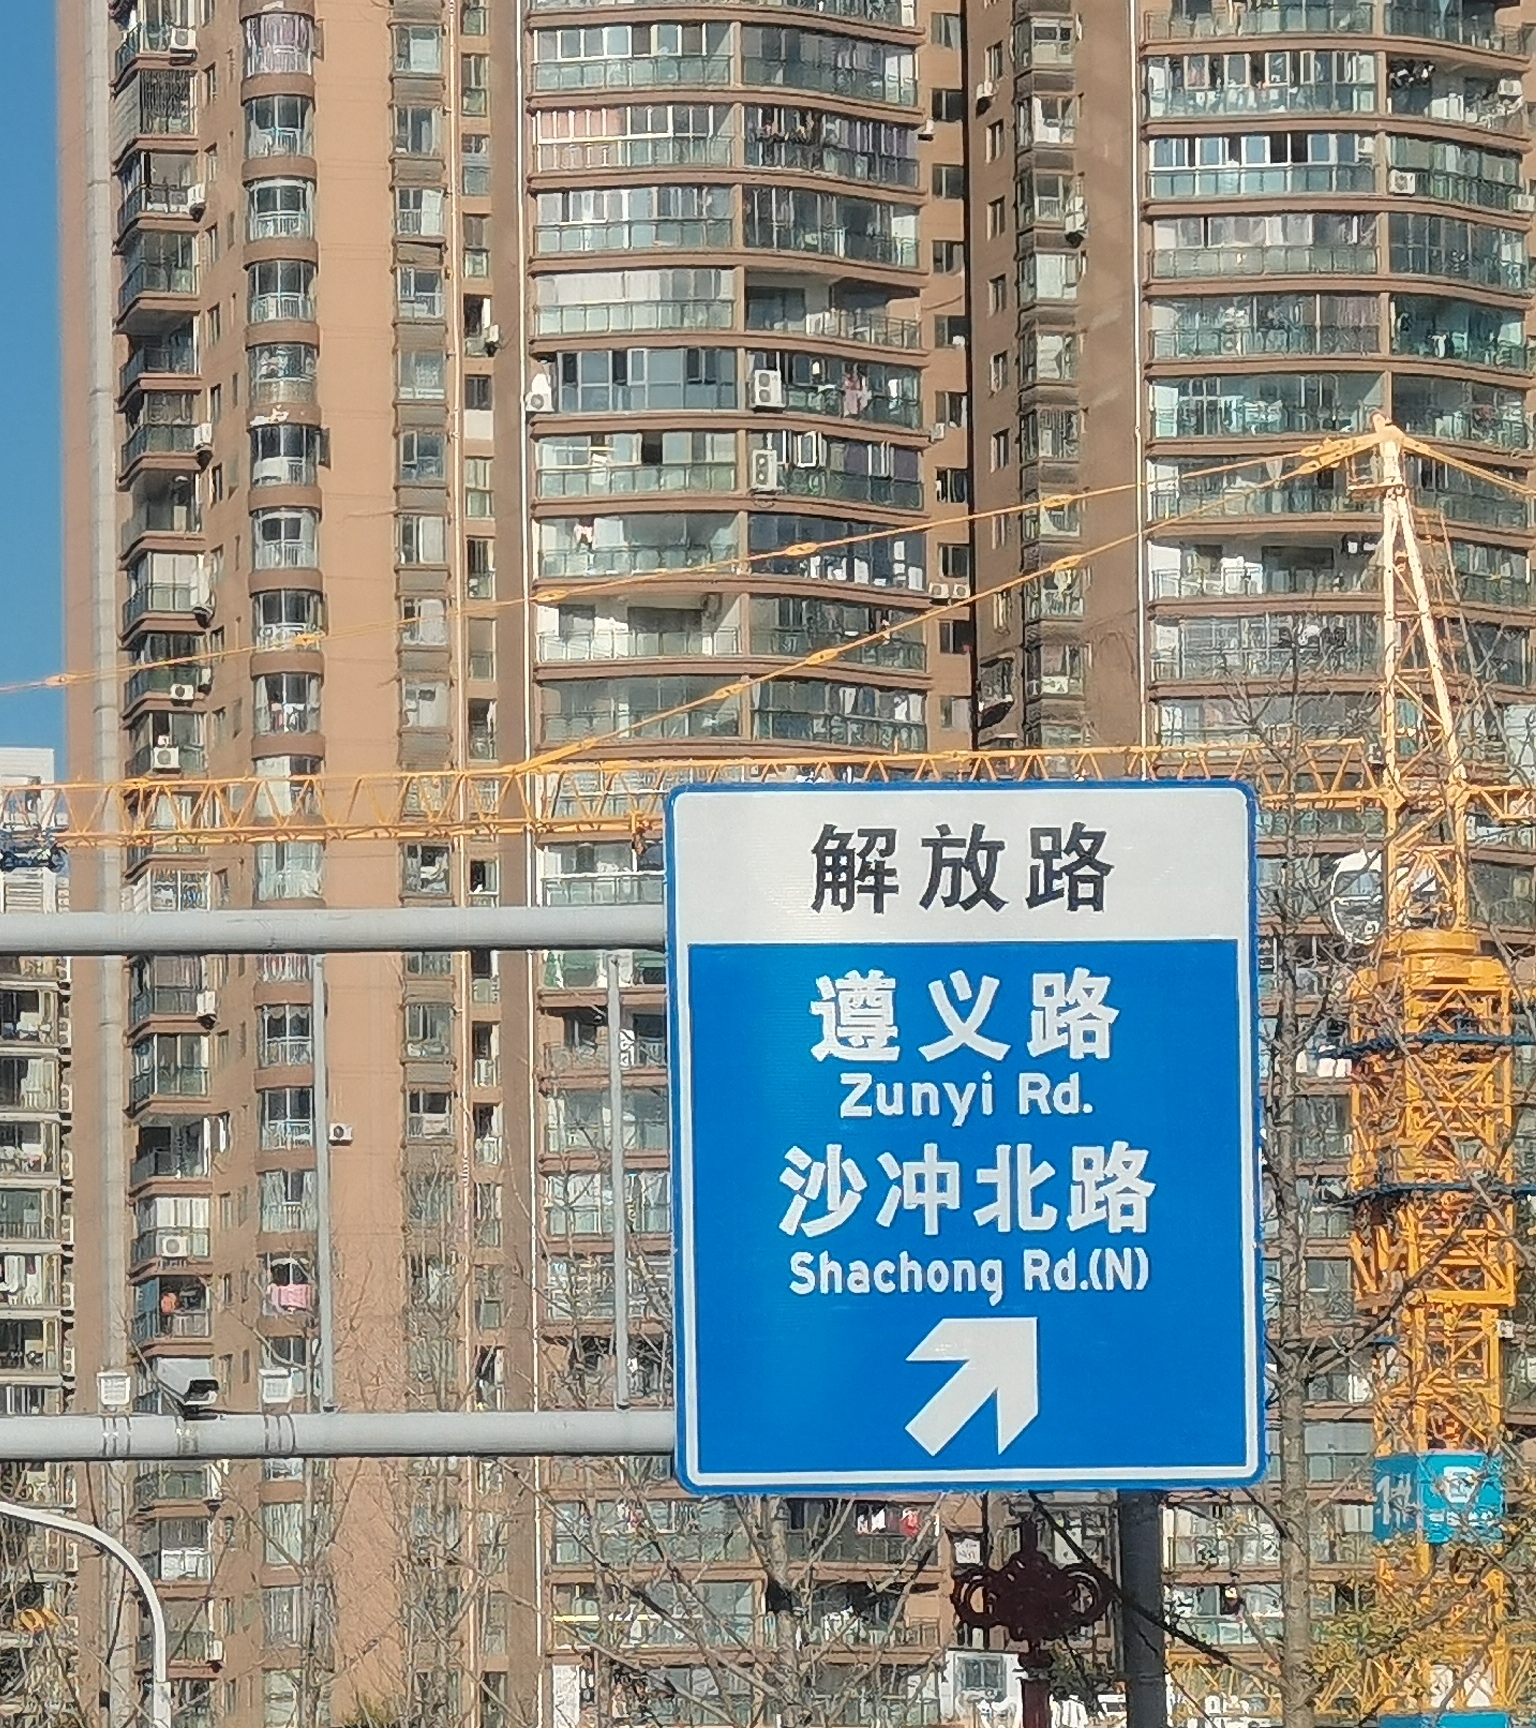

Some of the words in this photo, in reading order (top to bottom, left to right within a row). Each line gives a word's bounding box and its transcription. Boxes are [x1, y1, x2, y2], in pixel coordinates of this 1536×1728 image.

[810, 821, 1116, 914] 解放路
[810, 966, 1120, 1063] 遵义路
[840, 1070, 994, 1127] Zunyi
[1017, 1072, 1094, 1116] Rd.
[778, 1140, 1157, 1238] 沙冲北路
[788, 1249, 1004, 1307] Shachong
[1022, 1247, 1151, 1293] Rd.(N)
